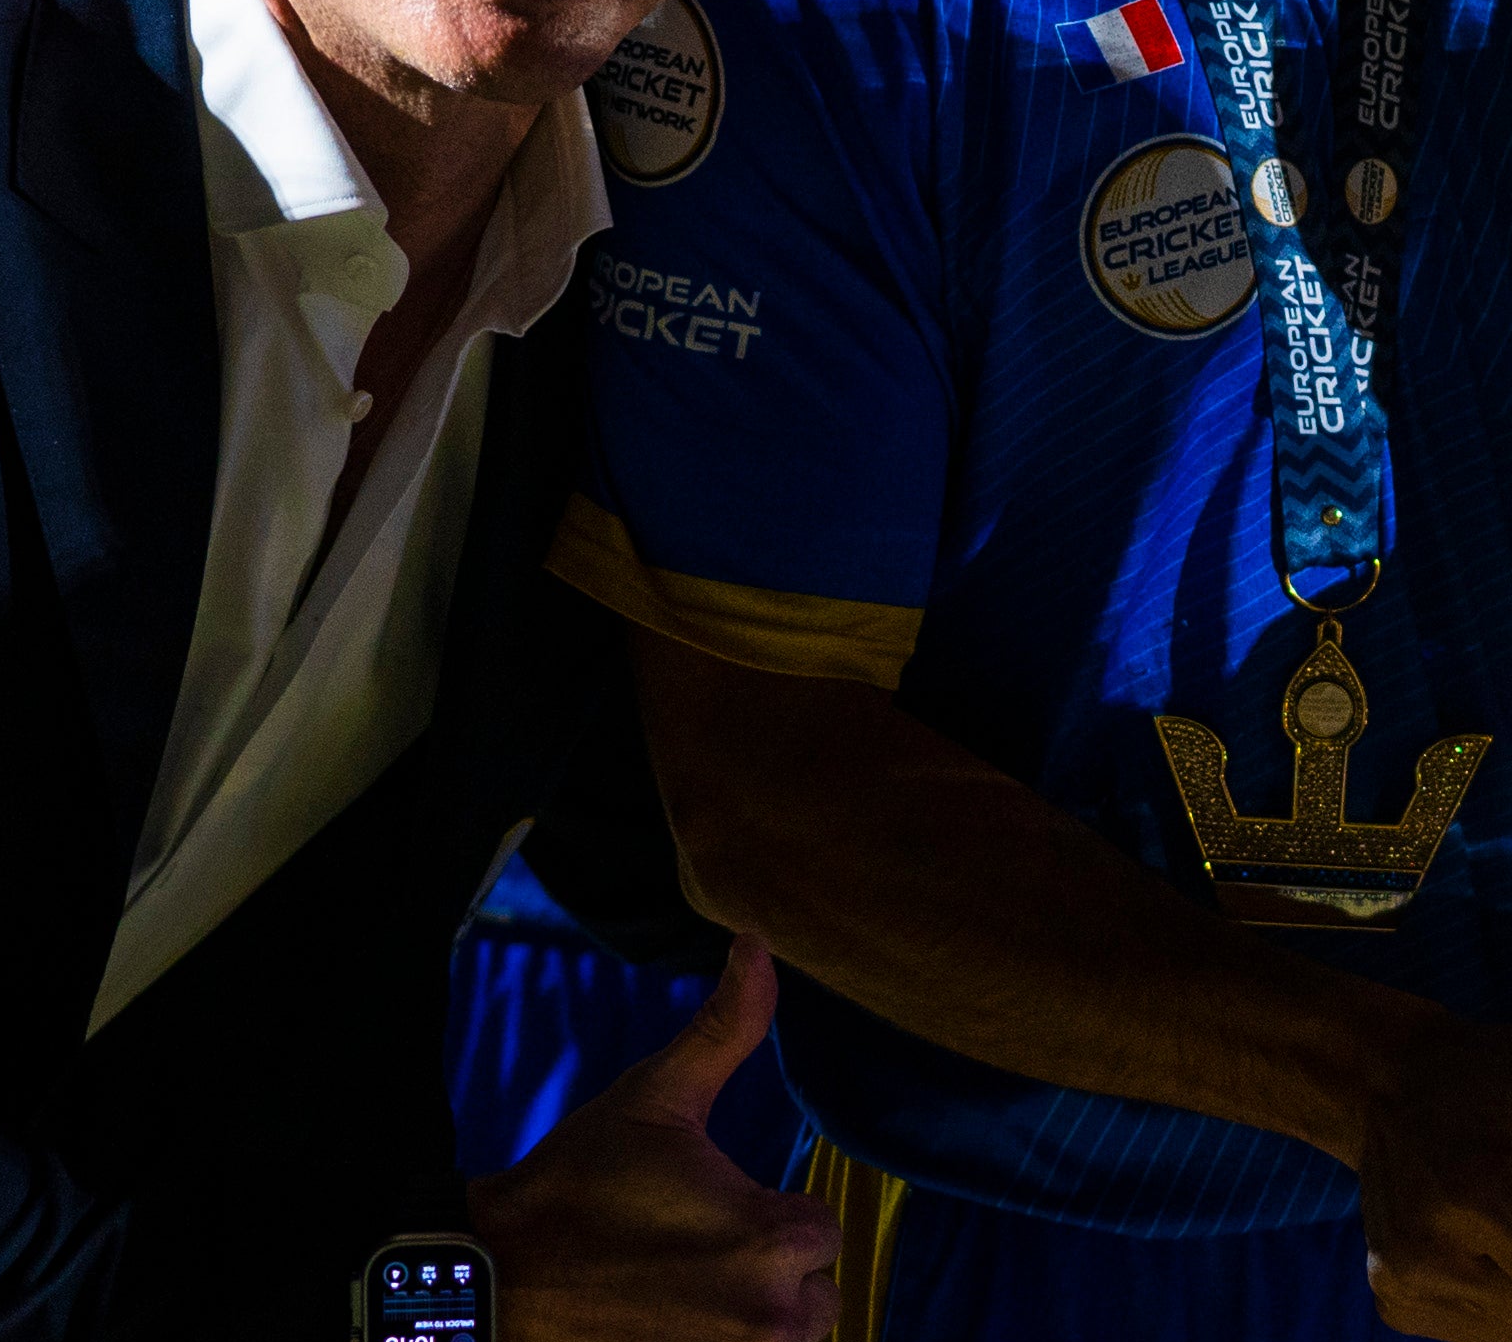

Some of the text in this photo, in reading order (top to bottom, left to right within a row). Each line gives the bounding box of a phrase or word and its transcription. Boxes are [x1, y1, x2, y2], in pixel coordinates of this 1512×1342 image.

[614, 39, 705, 78] ROPEAN
[1100, 188, 1238, 242] EUROPEAN
[1265, 164, 1283, 223] EUROPEAN
[1271, 161, 1292, 224] CRICKET
[1103, 210, 1248, 271] CRICKET
[1148, 239, 1248, 285] LEAGUE
[594, 251, 711, 318] ROPEAN
[1274, 257, 1317, 435] EUROPEAN
[1294, 255, 1345, 433] CRICKET
[414, 1319, 475, 1330] UNLOCK TO VIEW
